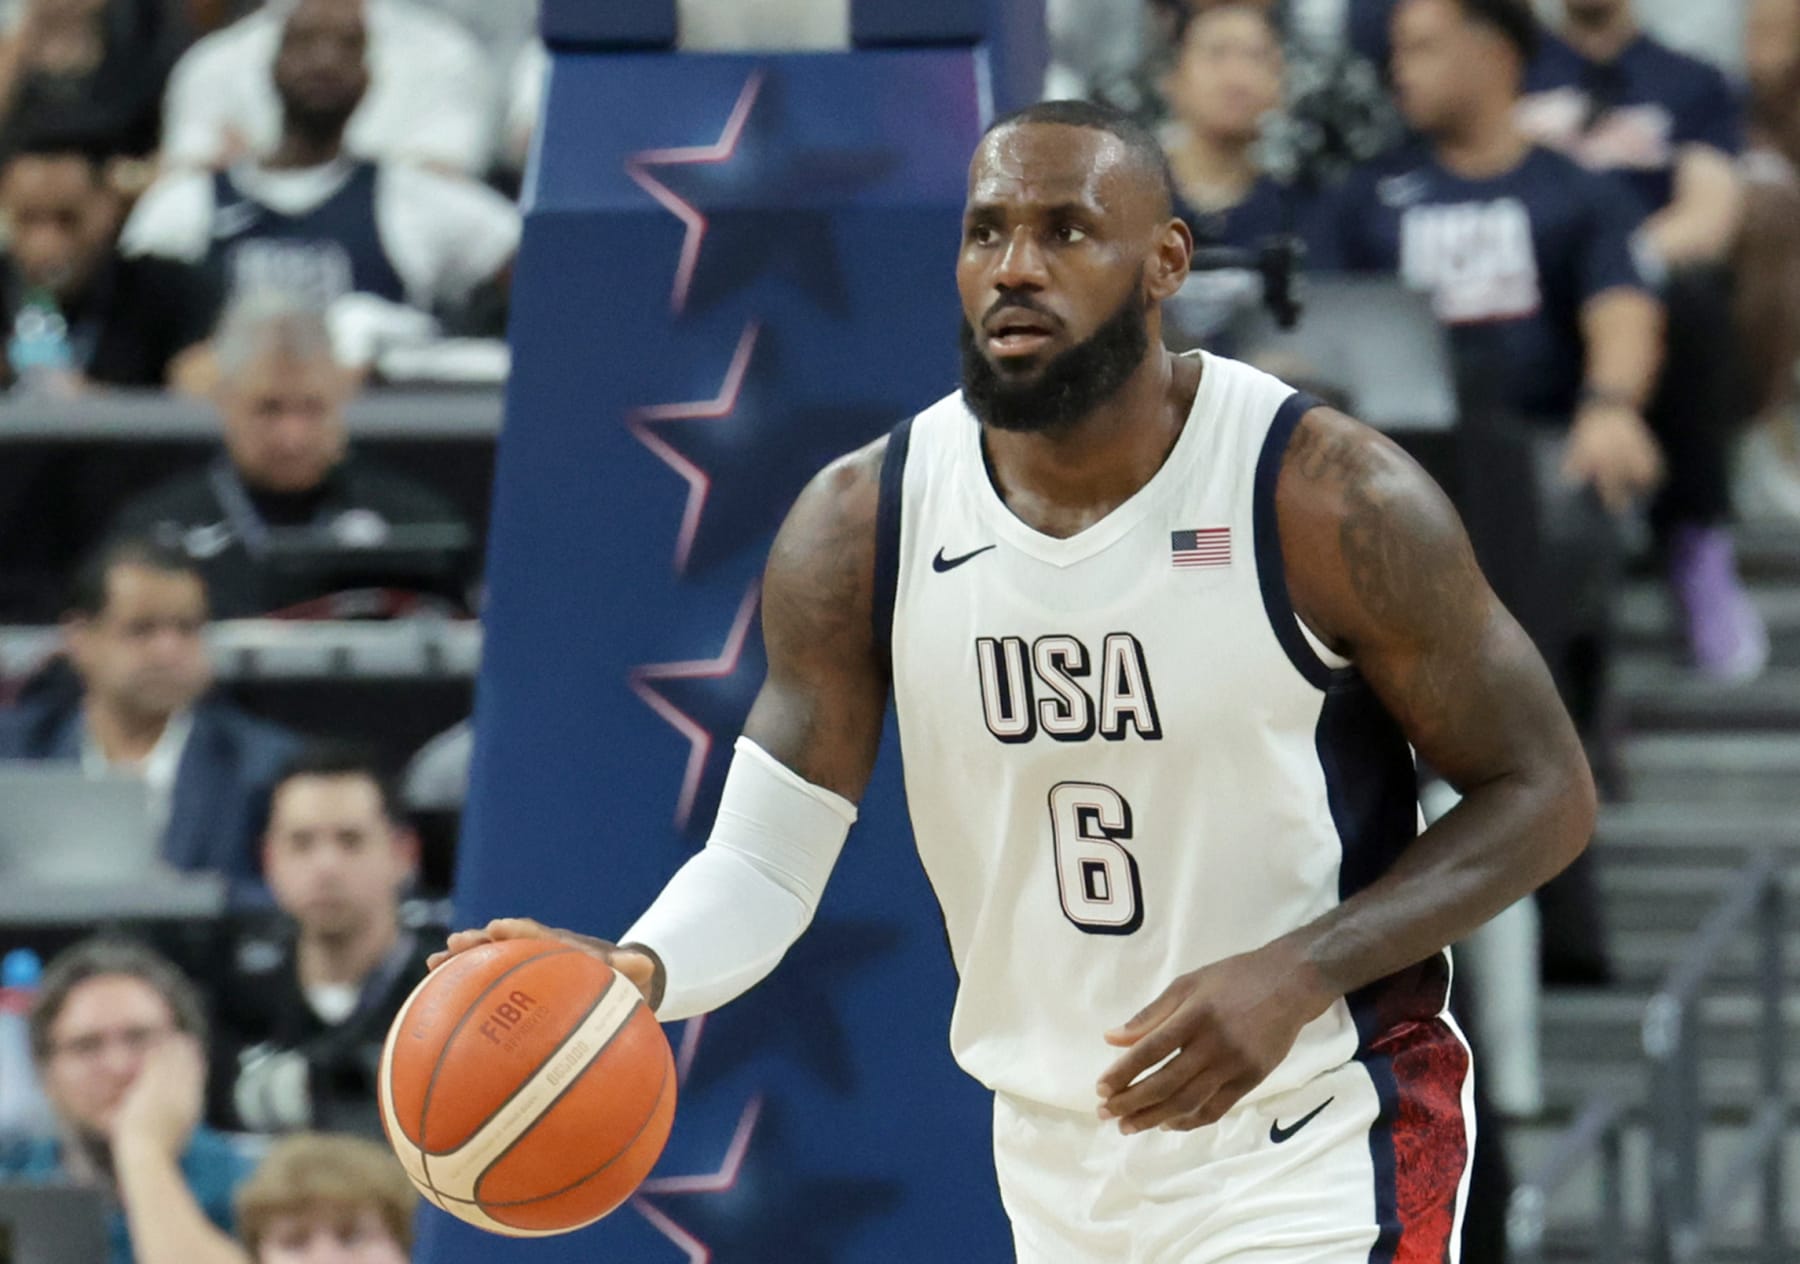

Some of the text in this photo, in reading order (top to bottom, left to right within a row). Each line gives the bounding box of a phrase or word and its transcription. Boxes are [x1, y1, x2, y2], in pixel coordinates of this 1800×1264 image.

[976, 632, 1163, 743] USA
[1048, 780, 1144, 935] 6
[479, 989, 537, 1045] FIBA
